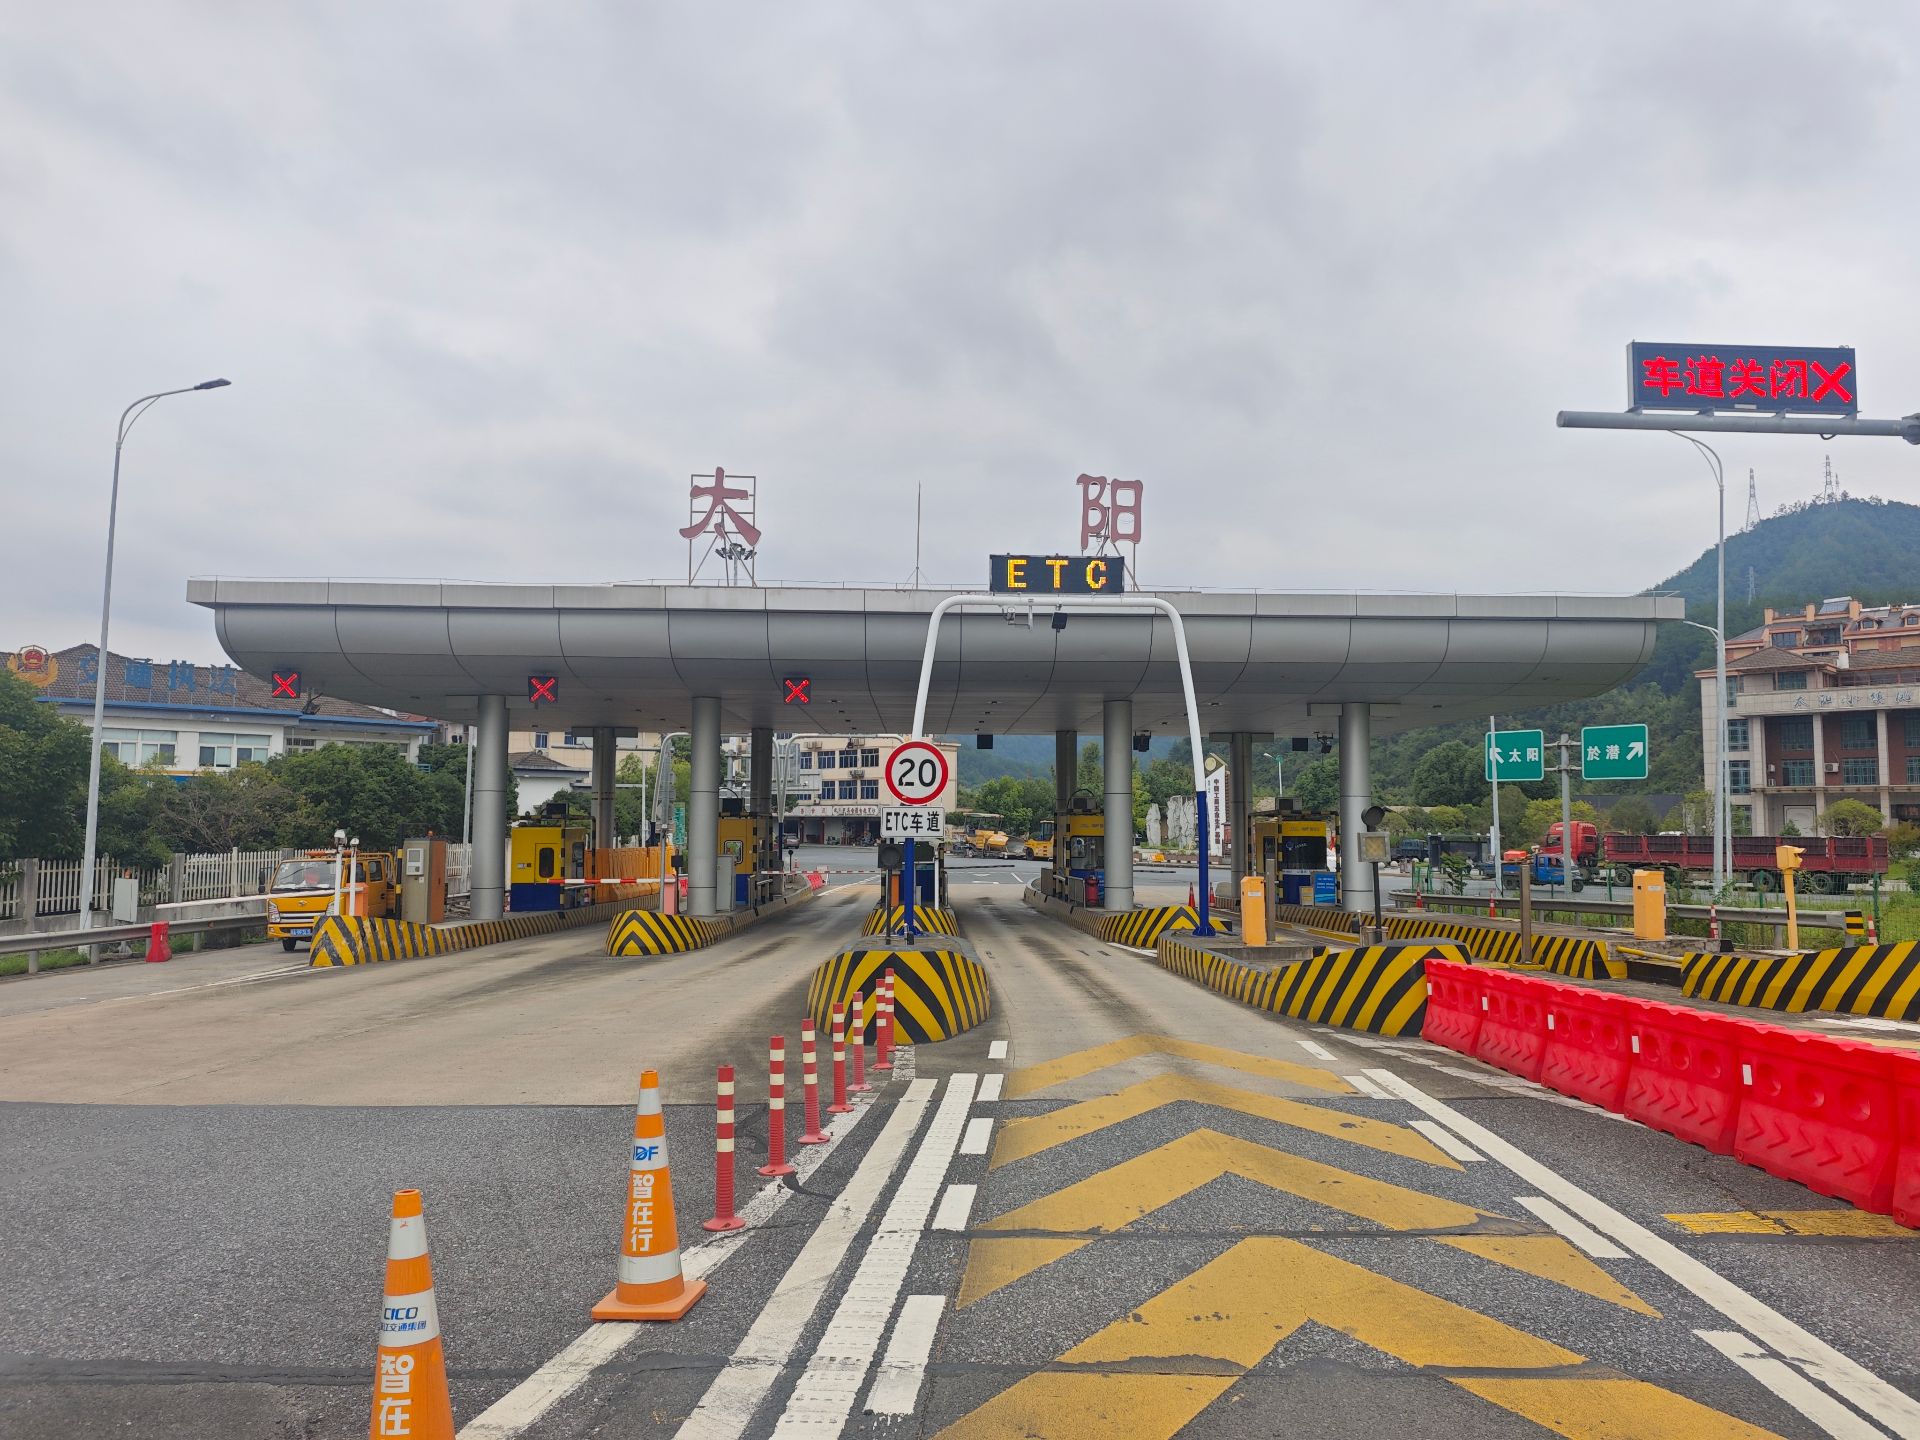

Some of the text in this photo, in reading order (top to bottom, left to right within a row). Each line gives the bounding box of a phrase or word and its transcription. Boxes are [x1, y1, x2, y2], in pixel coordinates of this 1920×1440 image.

[1007, 558, 1108, 590] ETC
[1508, 747, 1540, 763] 太阳
[1586, 744, 1621, 762] 於潜
[897, 757, 938, 788] 20
[885, 809, 941, 834] ETC车道
[630, 1173, 655, 1252] 智在行
[383, 1306, 419, 1320] CICO
[380, 1320, 427, 1332] 江交通集团
